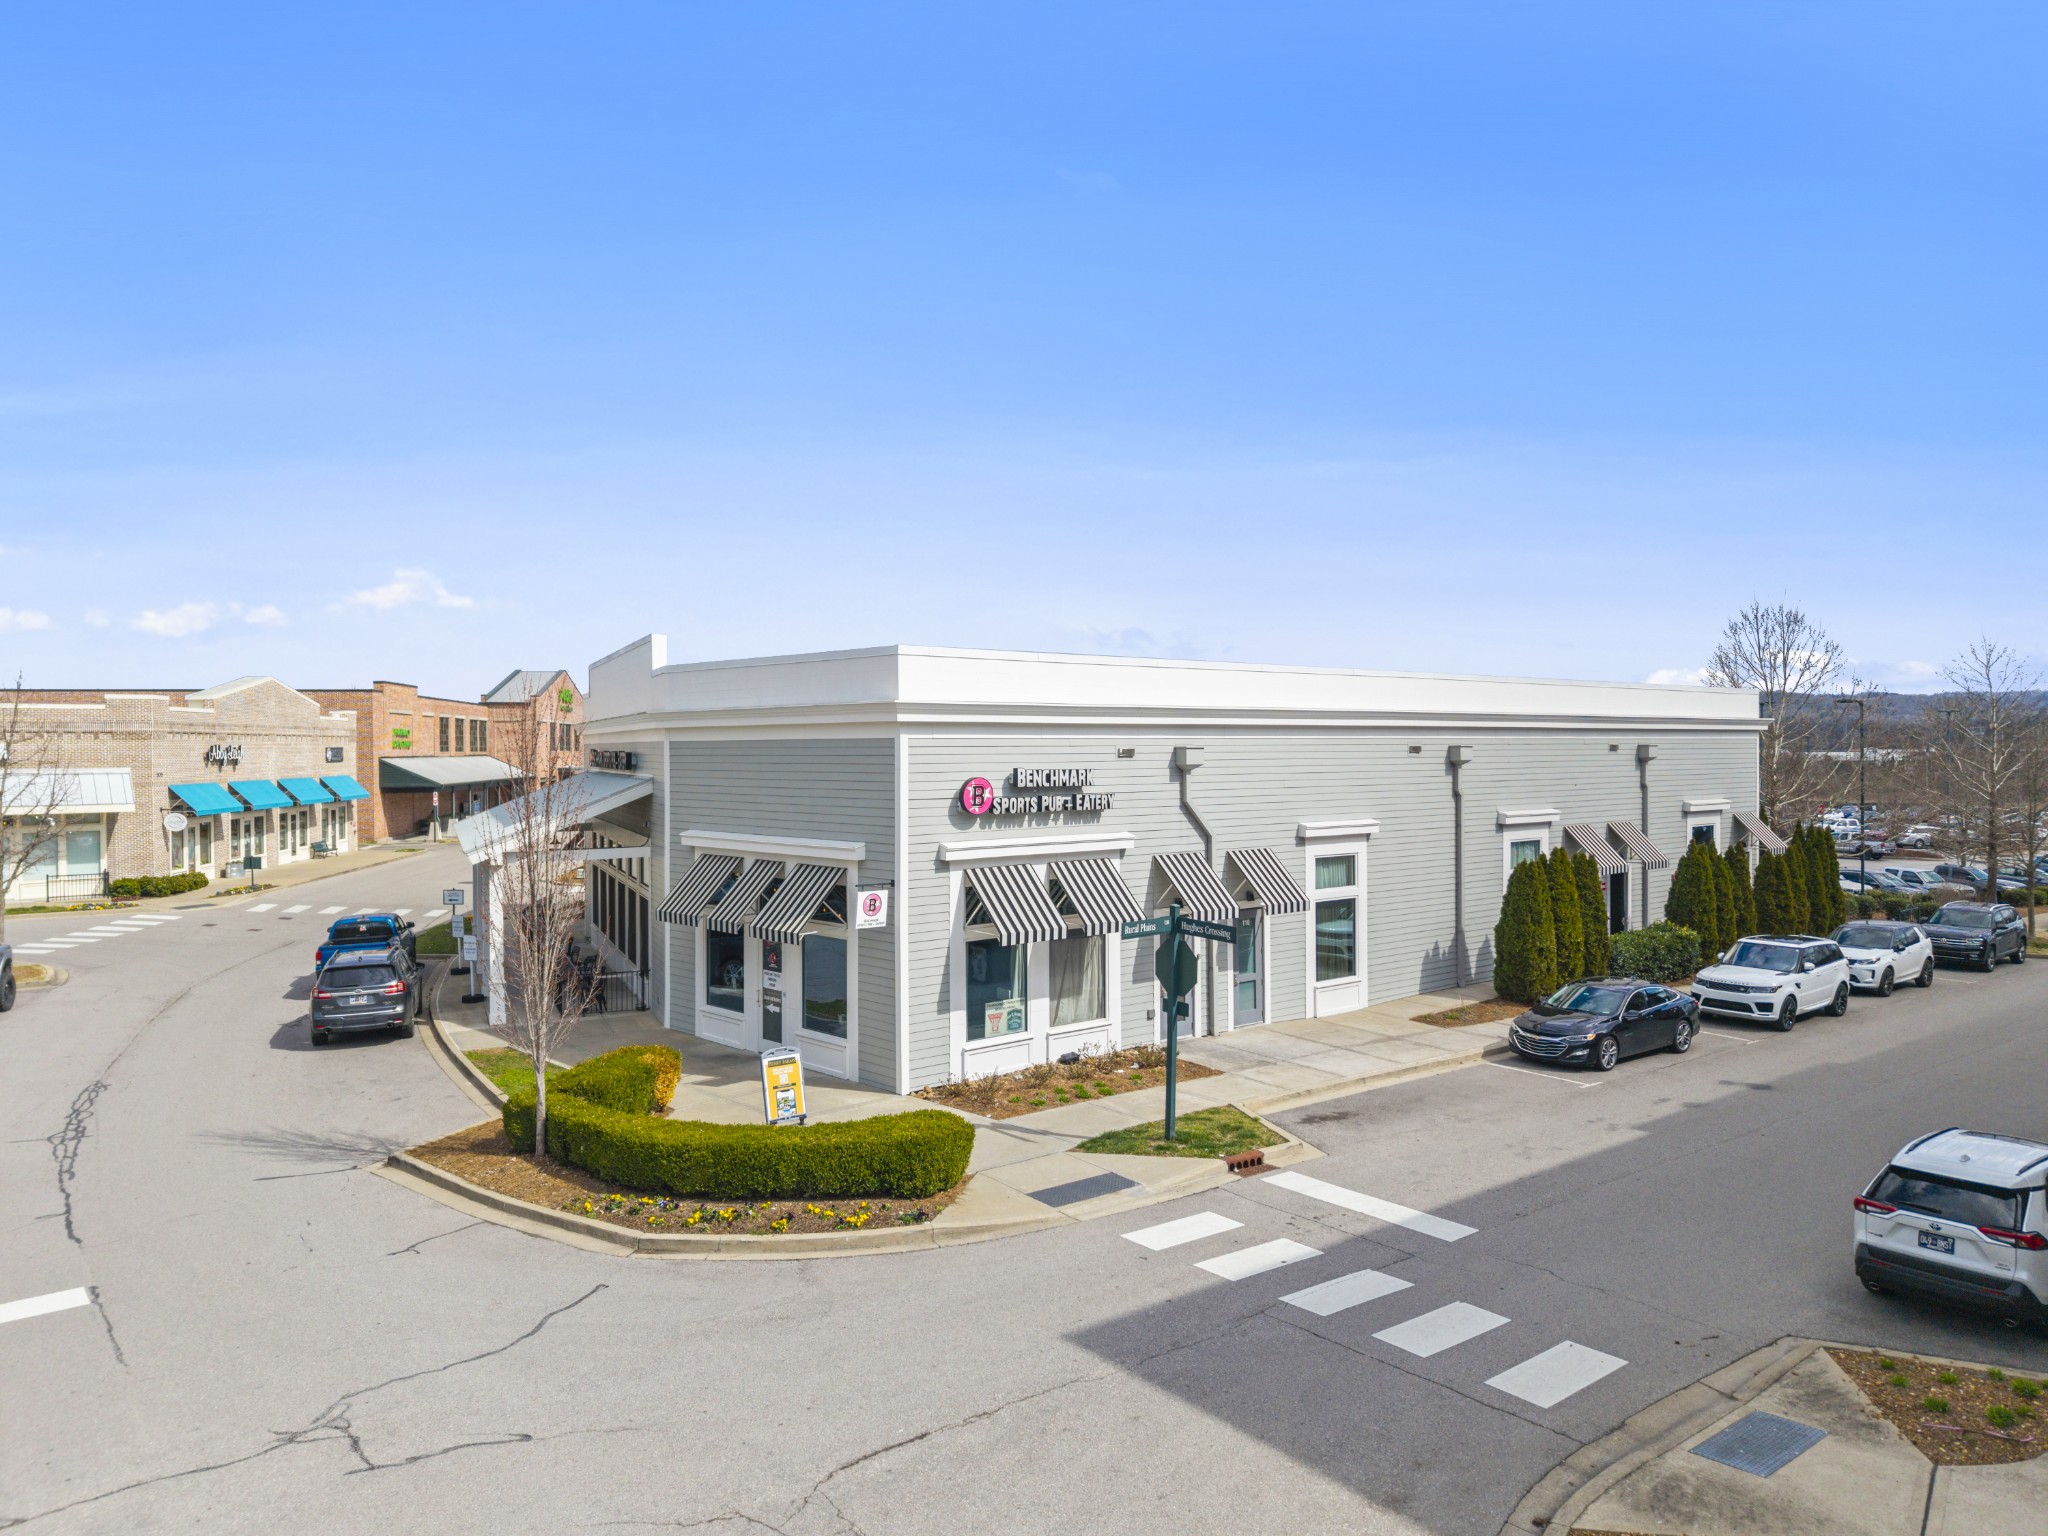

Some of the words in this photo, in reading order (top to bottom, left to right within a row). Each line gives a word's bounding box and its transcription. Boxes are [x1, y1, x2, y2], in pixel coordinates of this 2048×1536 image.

[1017, 767, 1096, 788] BENCHMARK
[971, 784, 987, 808] B
[992, 795, 1038, 815] SPORTS
[1041, 795, 1063, 813] PUB
[1076, 793, 1115, 811] EATERY
[1124, 924, 1140, 935] Rural
[1140, 922, 1157, 933] Plains
[1181, 921, 1204, 935] Hughes
[1204, 925, 1231, 940] Crossing
